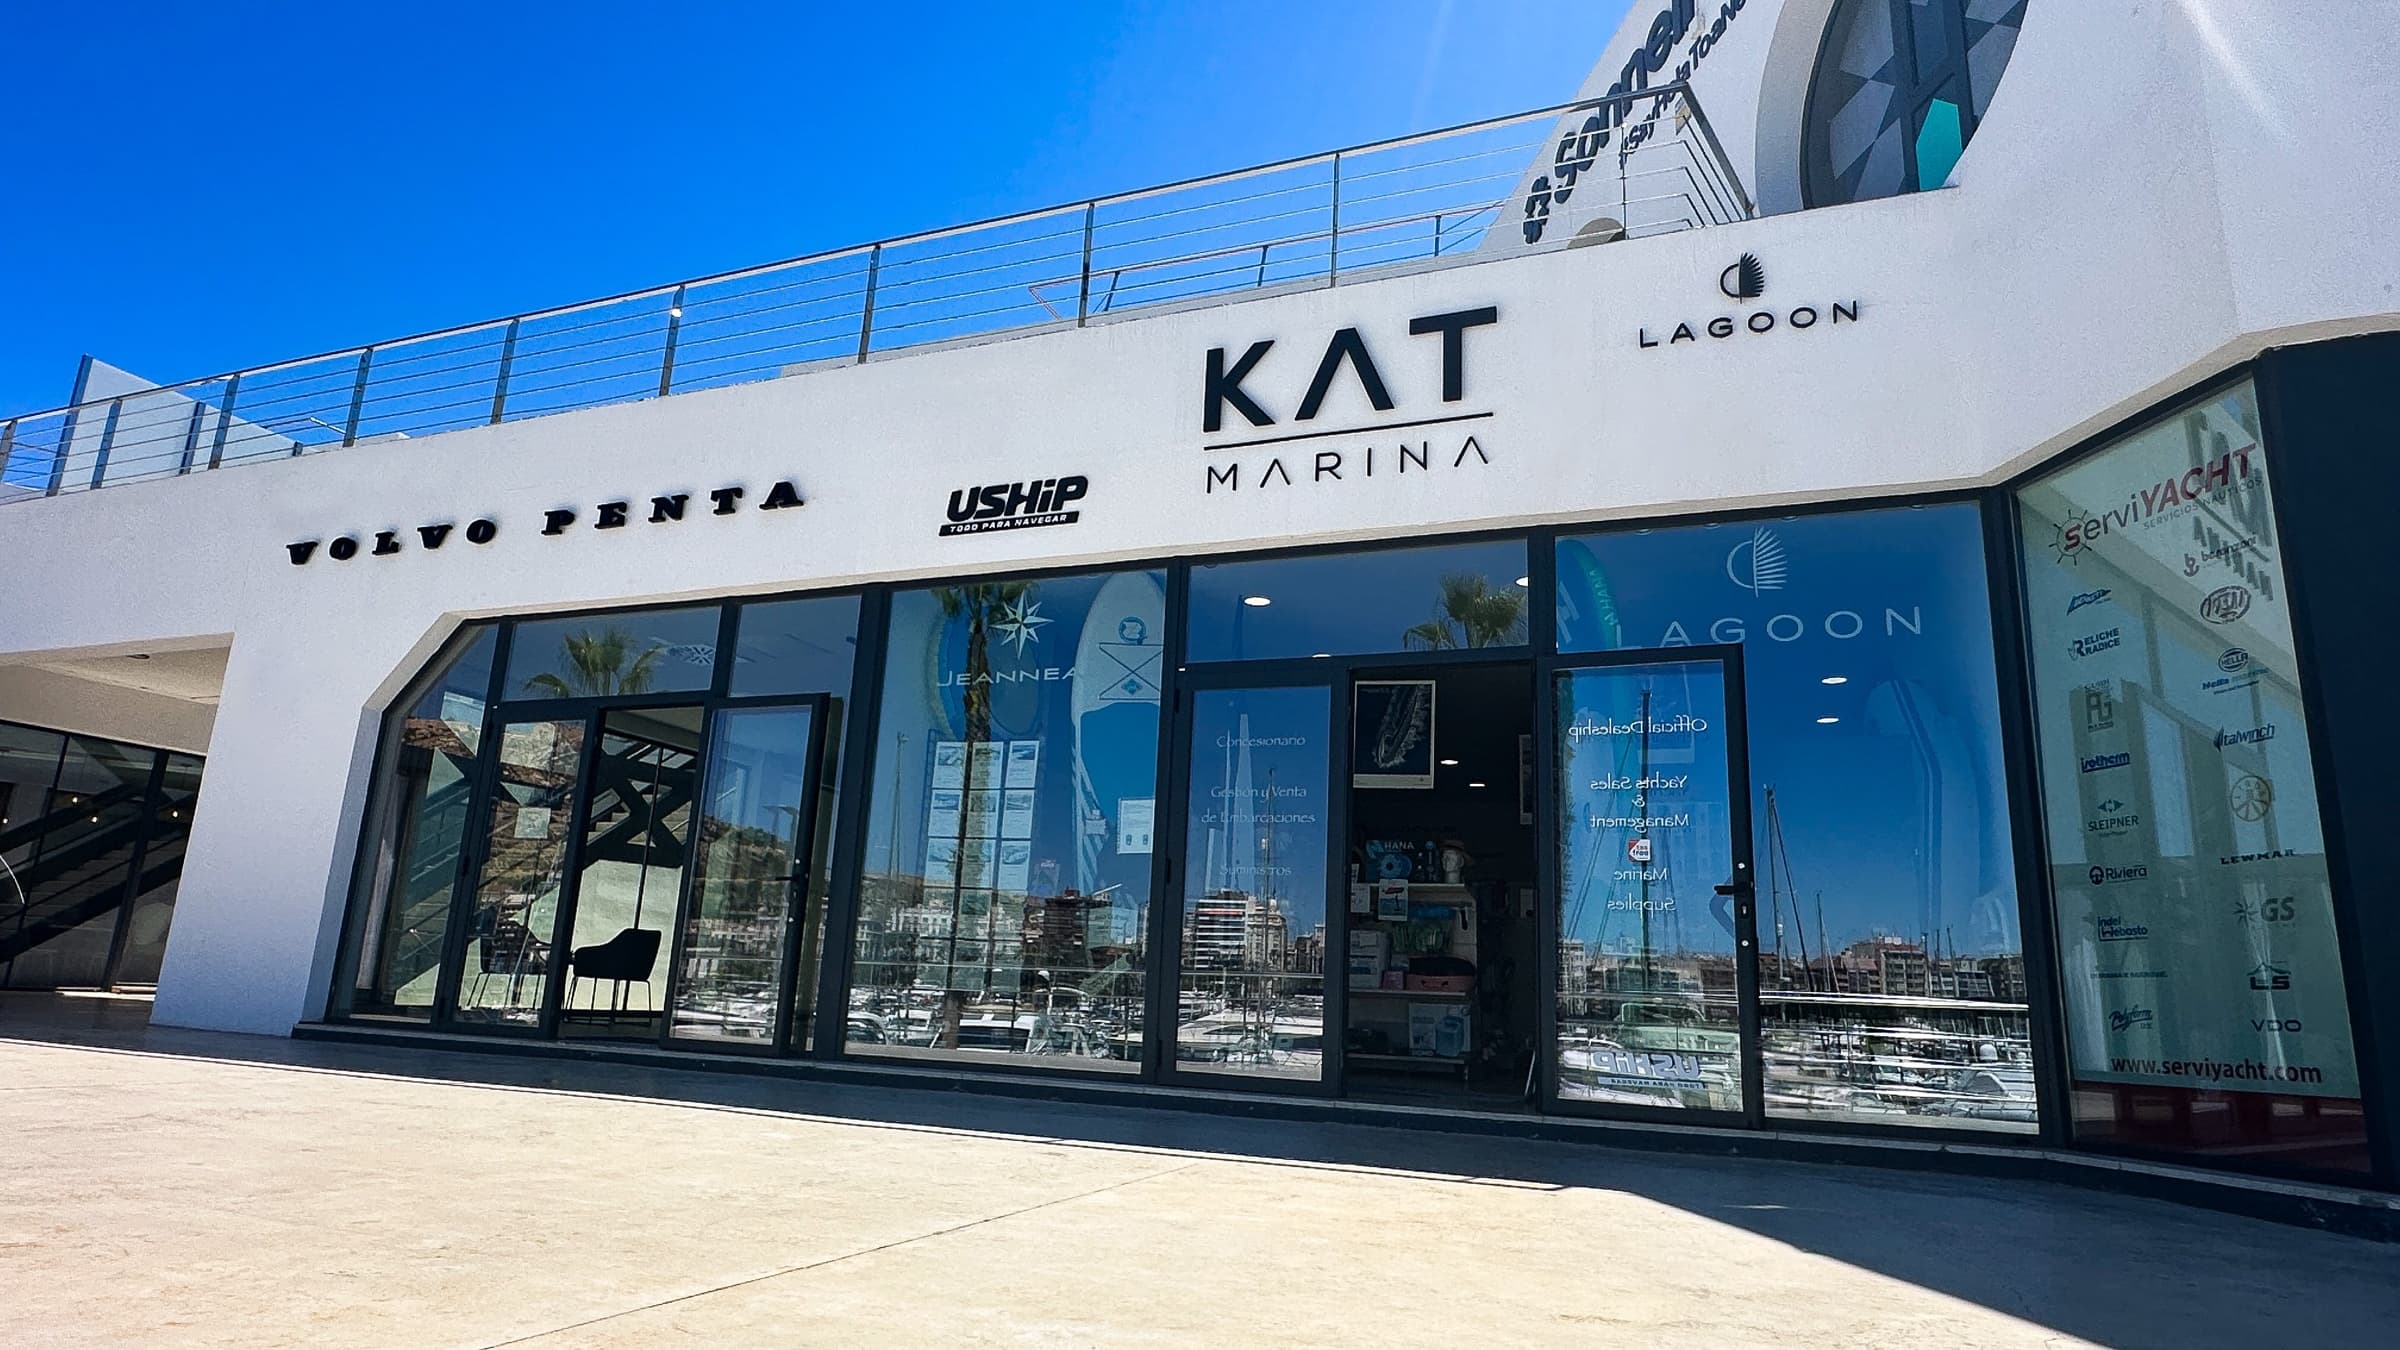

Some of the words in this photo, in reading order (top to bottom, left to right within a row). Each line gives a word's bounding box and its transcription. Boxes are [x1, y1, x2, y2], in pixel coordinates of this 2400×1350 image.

[1639, 300, 1858, 349] LAGOON
[1203, 306, 1498, 433] KAT
[1206, 436, 1489, 494] MARINA
[286, 519, 496, 565] VOLVO
[541, 481, 804, 536] PENTA
[950, 523, 979, 533] TODO
[982, 520, 1011, 530] PARA
[1014, 514, 1068, 527] NAVEGAR
[936, 666, 1076, 687] JEANNEA
[1201, 807, 1217, 823] de
[2251, 1018, 2303, 1033] VDO
[2110, 1056, 2323, 1084] www.serviyacht.com
